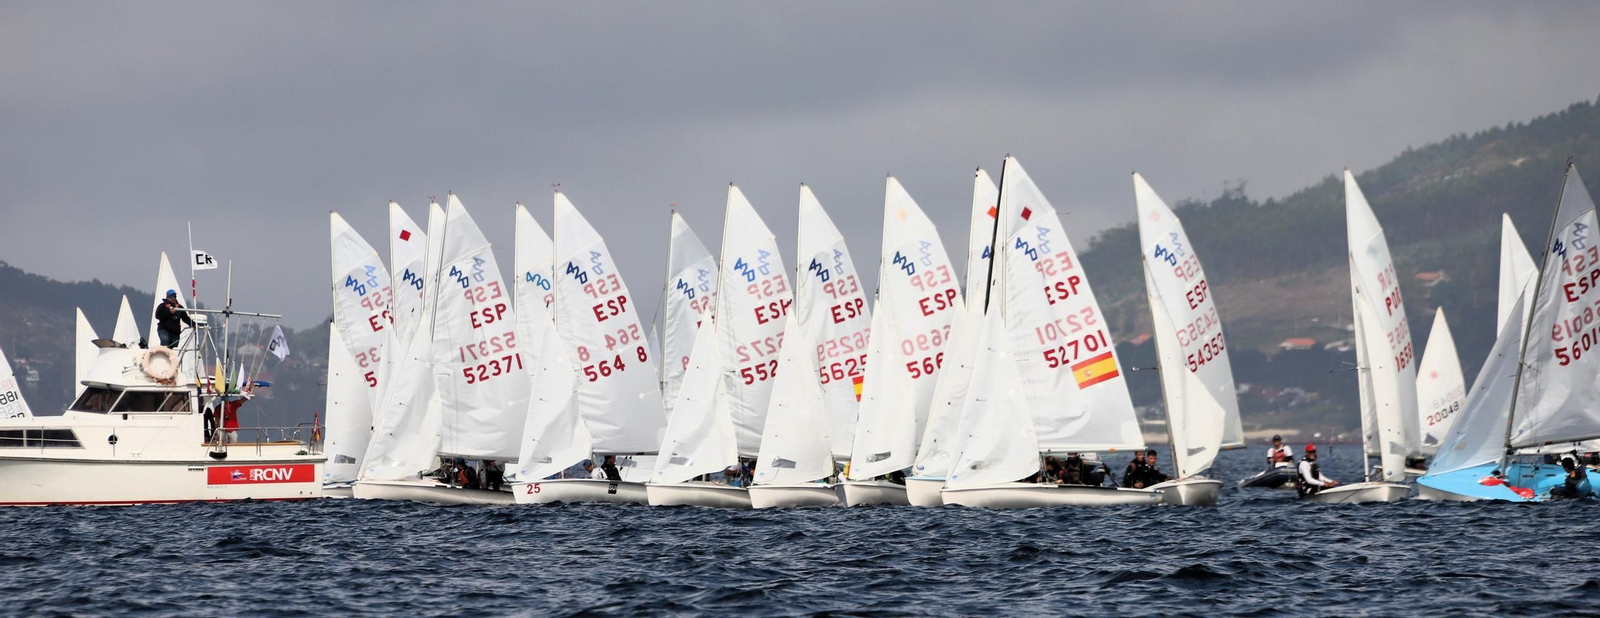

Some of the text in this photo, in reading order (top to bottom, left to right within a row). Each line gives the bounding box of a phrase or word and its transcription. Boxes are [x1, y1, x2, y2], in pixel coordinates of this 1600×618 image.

[1015, 236, 1038, 261] 420
[1154, 243, 1177, 267] 420
[566, 261, 588, 284] 420
[734, 257, 755, 282] 420
[809, 258, 830, 282] 420
[893, 251, 916, 276] 420
[345, 274, 366, 296] 420
[402, 268, 424, 291] 420
[449, 265, 469, 289] 420
[525, 271, 551, 291] 420
[676, 278, 695, 299] 420
[1562, 268, 1600, 303] ESP
[918, 288, 957, 317] ESP
[1044, 275, 1081, 306] ESP
[1185, 279, 1208, 310] ESP
[470, 303, 507, 329] ESP
[592, 295, 627, 322] ESP
[831, 297, 864, 324] ESP
[1043, 329, 1108, 369] 52701
[1187, 332, 1225, 373] 54353
[1554, 326, 1600, 367] 5601
[463, 353, 523, 384] 52371
[1427, 401, 1460, 426] 20048
[255, 467, 293, 481] RCNV
[527, 483, 541, 495] 25
